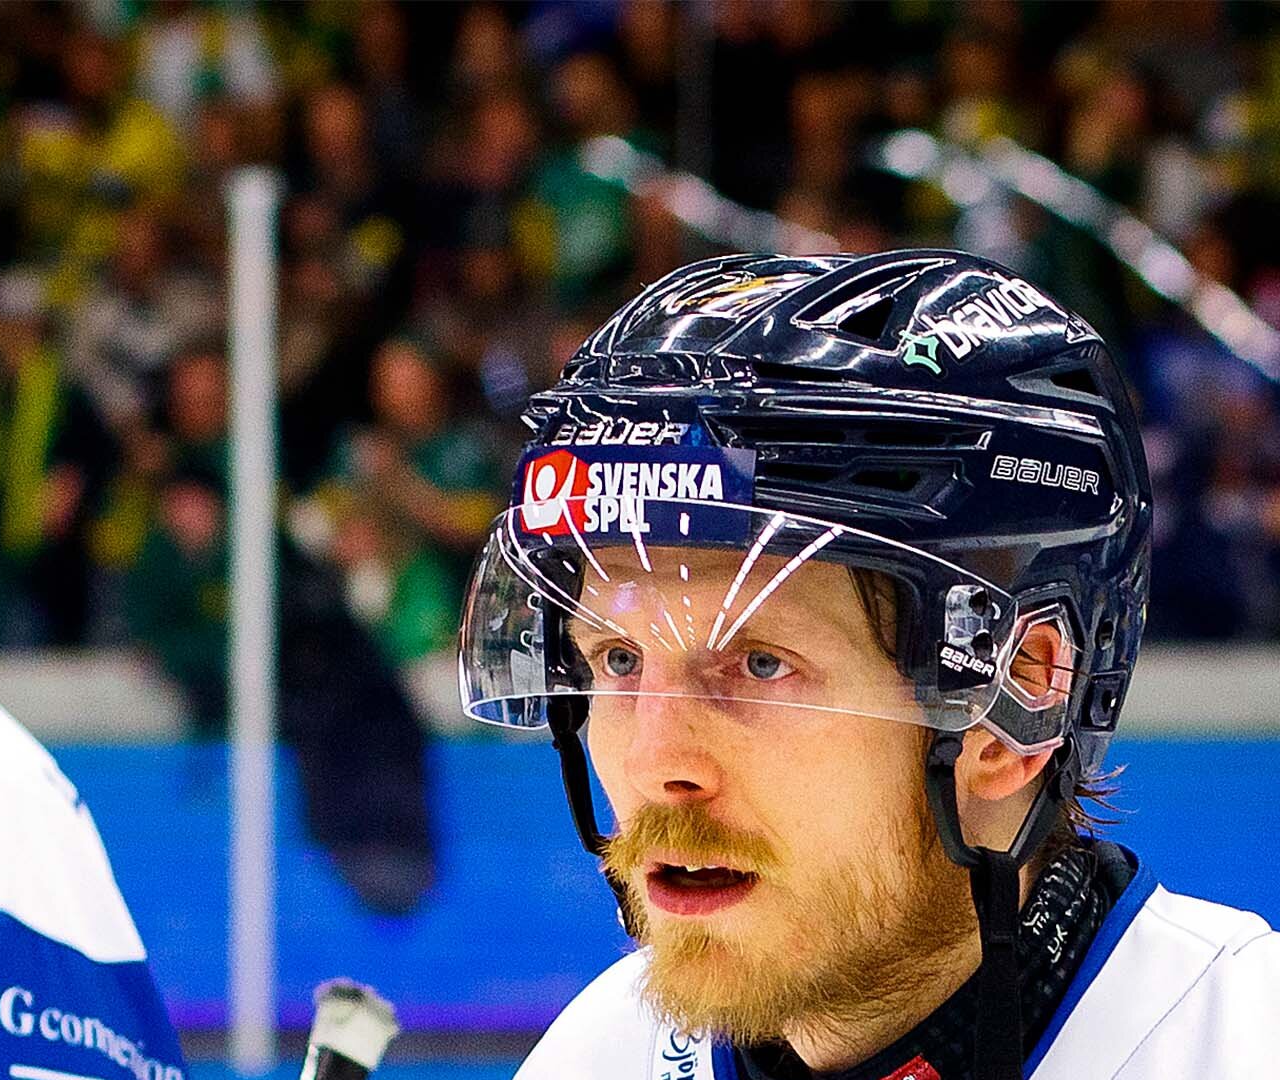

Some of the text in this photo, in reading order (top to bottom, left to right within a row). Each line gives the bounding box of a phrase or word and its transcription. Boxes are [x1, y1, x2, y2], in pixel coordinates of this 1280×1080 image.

[588, 462, 724, 500] SVENSKA
[990, 455, 1100, 495] BAUER
[584, 497, 651, 533] SPEL
[940, 645, 995, 677] BAUER
